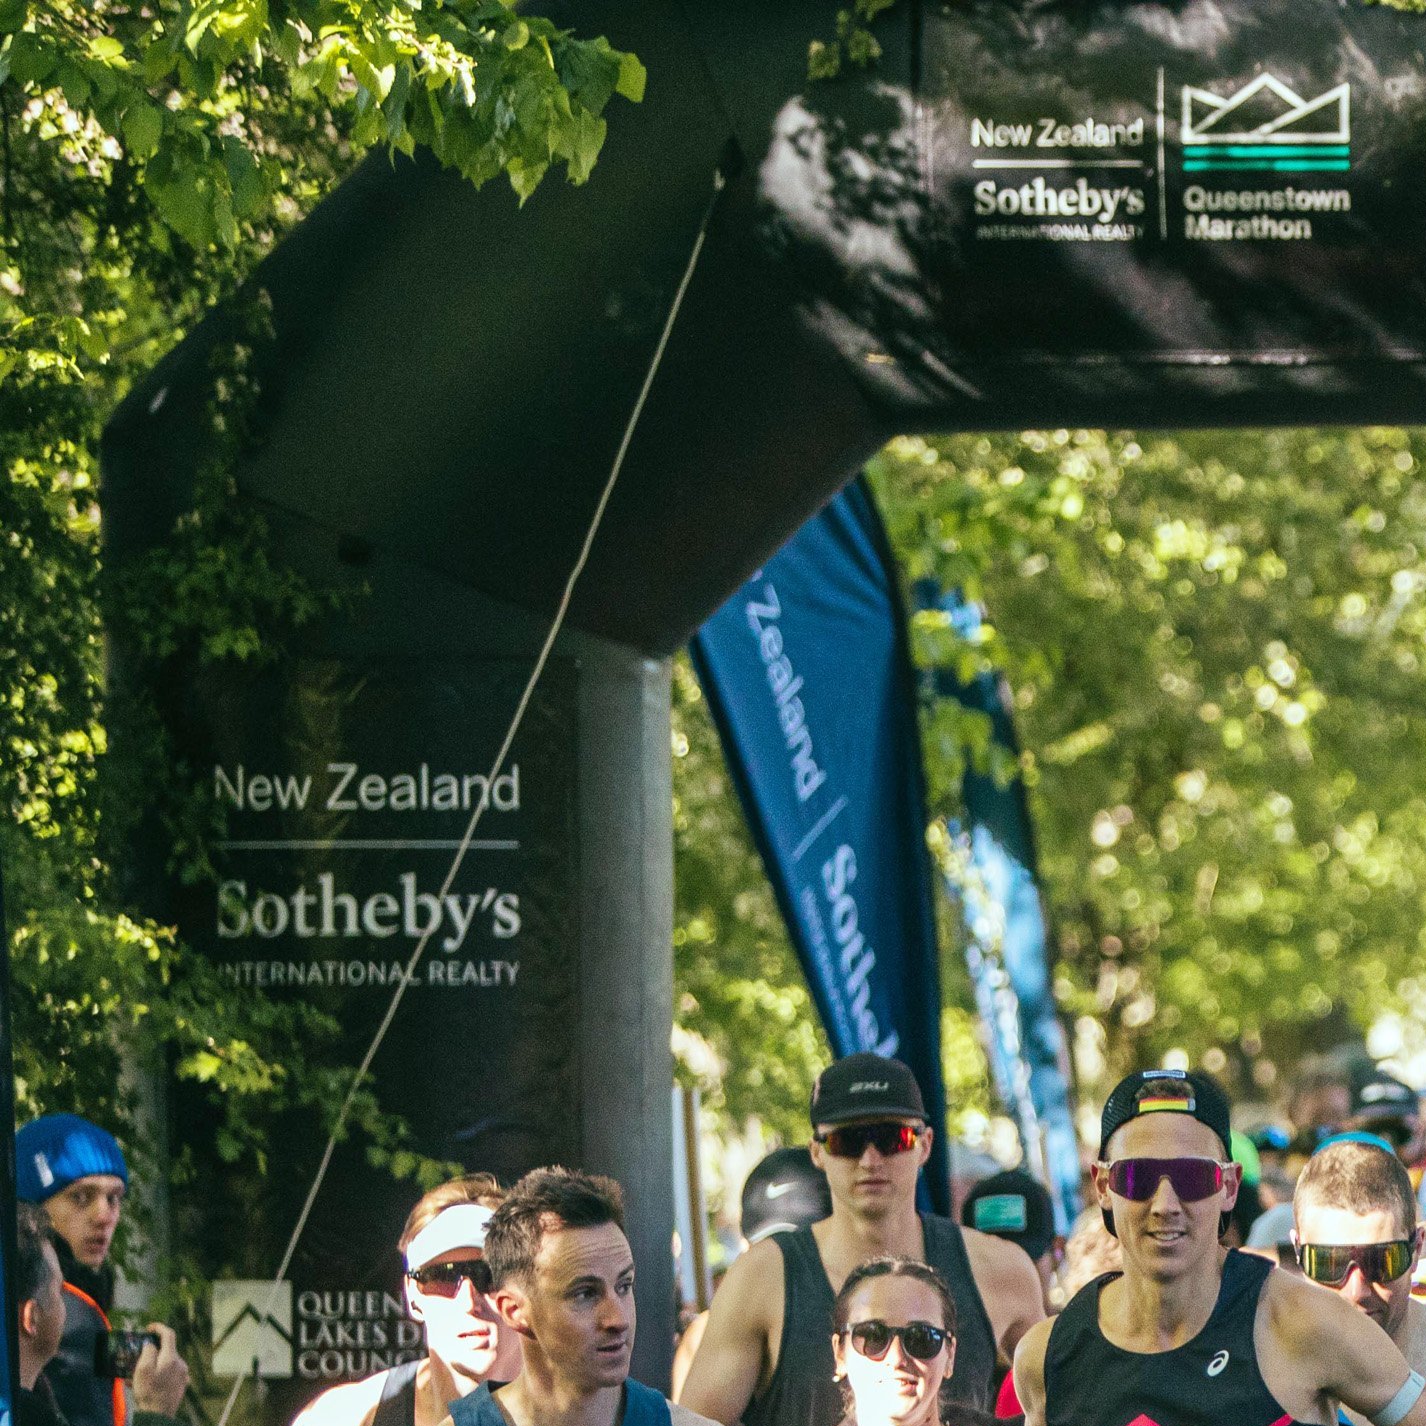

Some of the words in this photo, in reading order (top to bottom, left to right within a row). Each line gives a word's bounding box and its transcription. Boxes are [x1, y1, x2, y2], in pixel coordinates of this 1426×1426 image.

[972, 118, 1031, 148] New
[1036, 117, 1143, 148] Zealand
[974, 178, 1145, 222] Sotheby's
[1183, 186, 1350, 215] Queenstown
[1184, 213, 1311, 241] Marathon
[746, 584, 827, 800] Zealand
[214, 764, 313, 811] New
[326, 763, 520, 811] Zealand
[217, 872, 521, 952] Sotheby's
[429, 960, 520, 987] REALTY
[298, 1290, 405, 1320] QUEEN
[300, 1320, 389, 1349] LAKES
[397, 1320, 422, 1349] D
